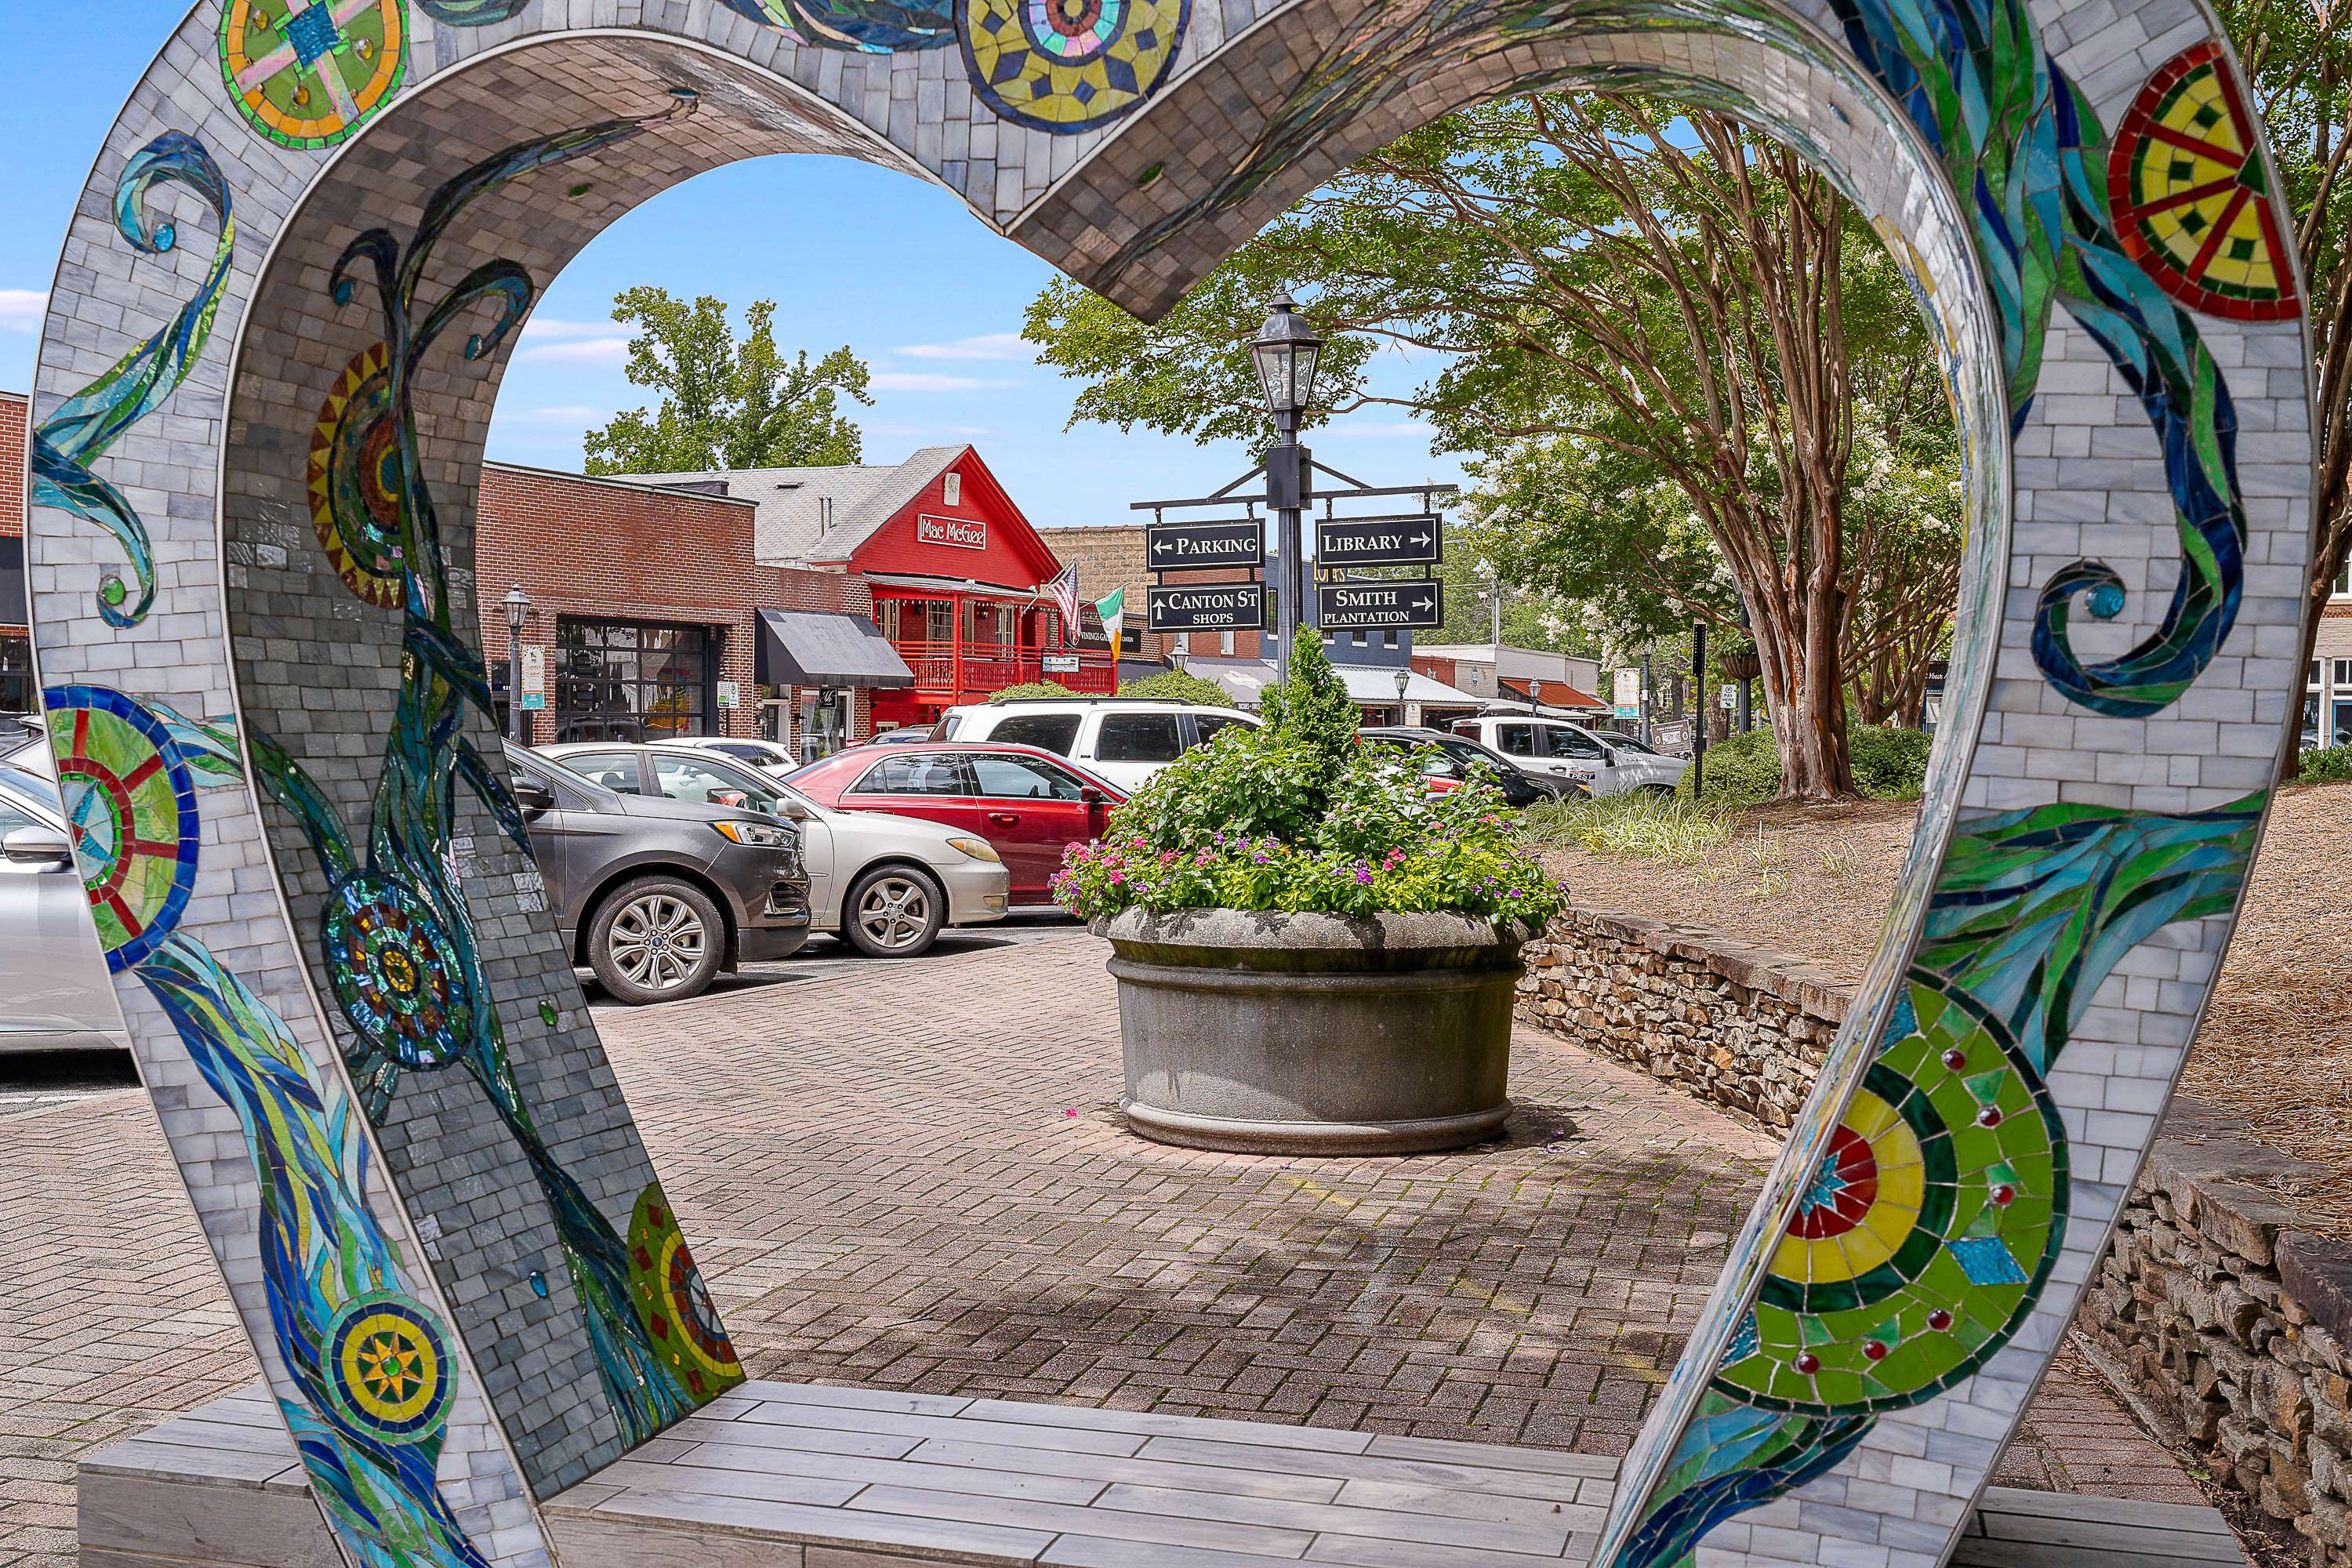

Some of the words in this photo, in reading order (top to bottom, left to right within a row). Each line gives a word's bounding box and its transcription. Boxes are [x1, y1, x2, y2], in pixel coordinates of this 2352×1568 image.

[922, 519, 944, 539] Mac
[946, 522, 984, 545] McGee
[1176, 538, 1256, 555] PARKING
[1323, 535, 1403, 552] LIBRARY
[1168, 593, 1235, 610] CANTON
[1237, 590, 1258, 608] ST
[1336, 590, 1398, 607] SMITH
[1192, 612, 1234, 625] SHOPS
[1323, 611, 1410, 624] PLANTATION
[1928, 672, 1944, 681] Your
